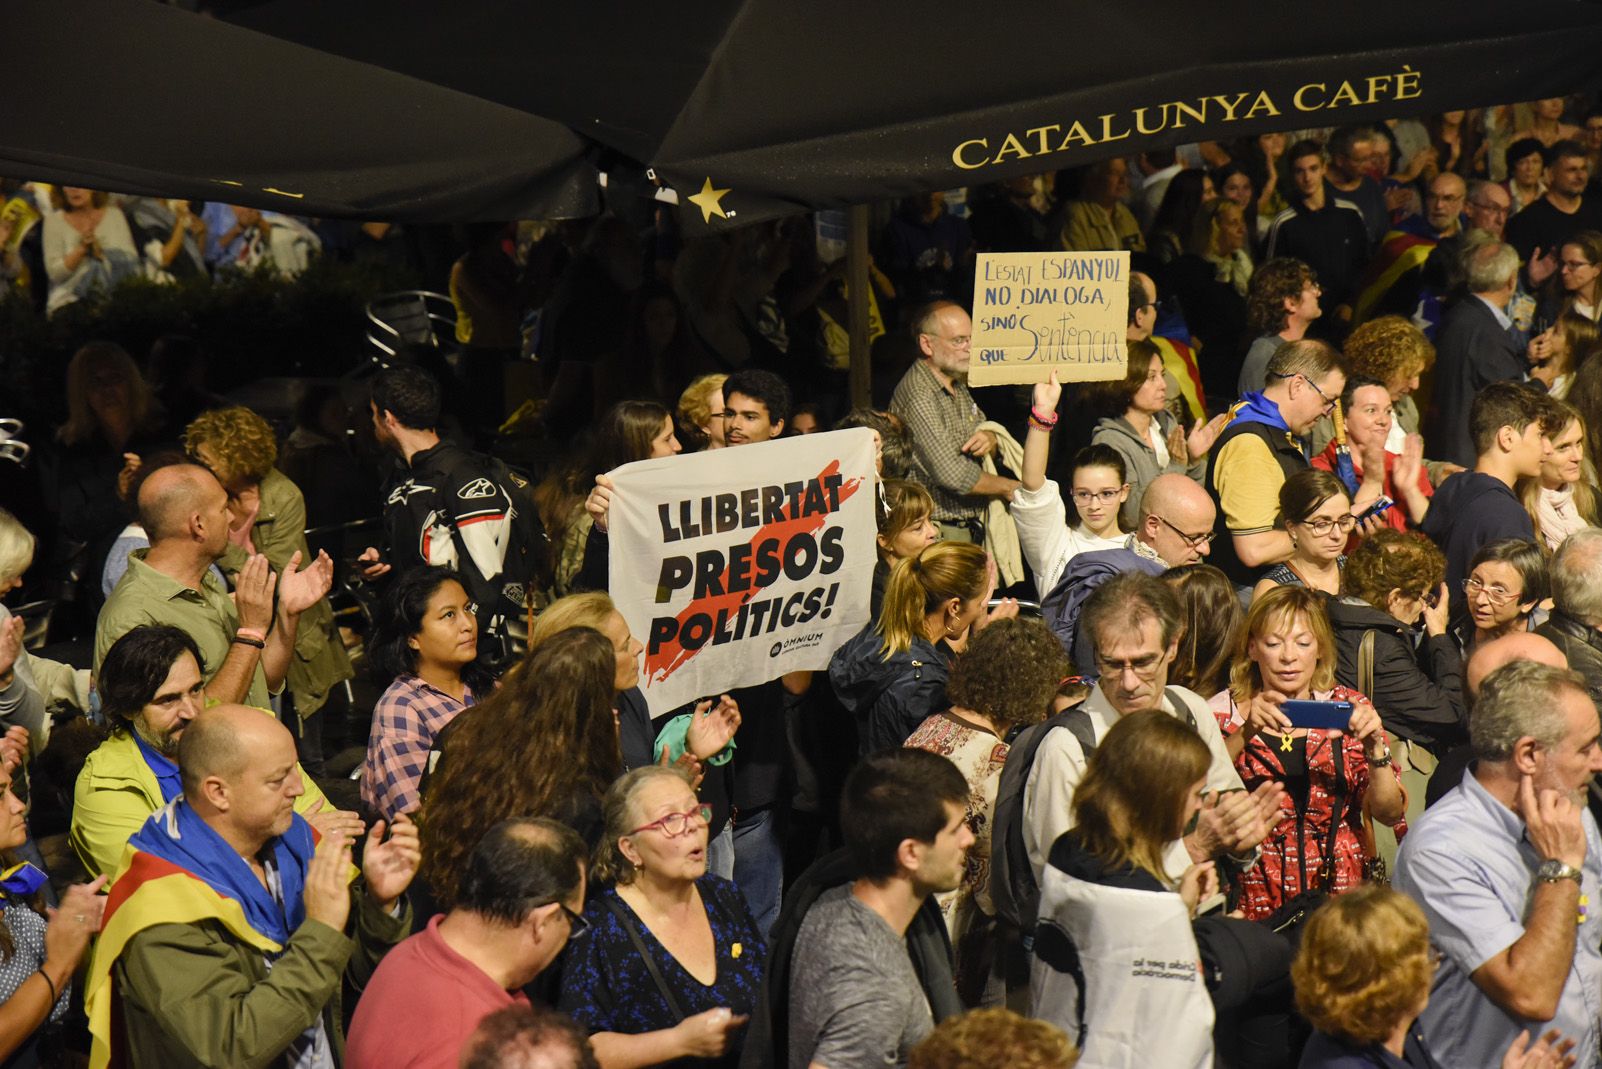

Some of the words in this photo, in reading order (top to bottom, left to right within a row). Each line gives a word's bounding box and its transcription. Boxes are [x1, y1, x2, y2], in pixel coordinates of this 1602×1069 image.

[952, 90, 1281, 170] CATALUNYA
[1293, 65, 1423, 112] CAFÈ
[1042, 257, 1124, 282] ESPANYOL
[980, 349, 1009, 365] QUE
[658, 474, 843, 543] LLIBERTAT
[654, 526, 845, 603] PRESOS
[649, 582, 840, 655] POLÍTICS!
